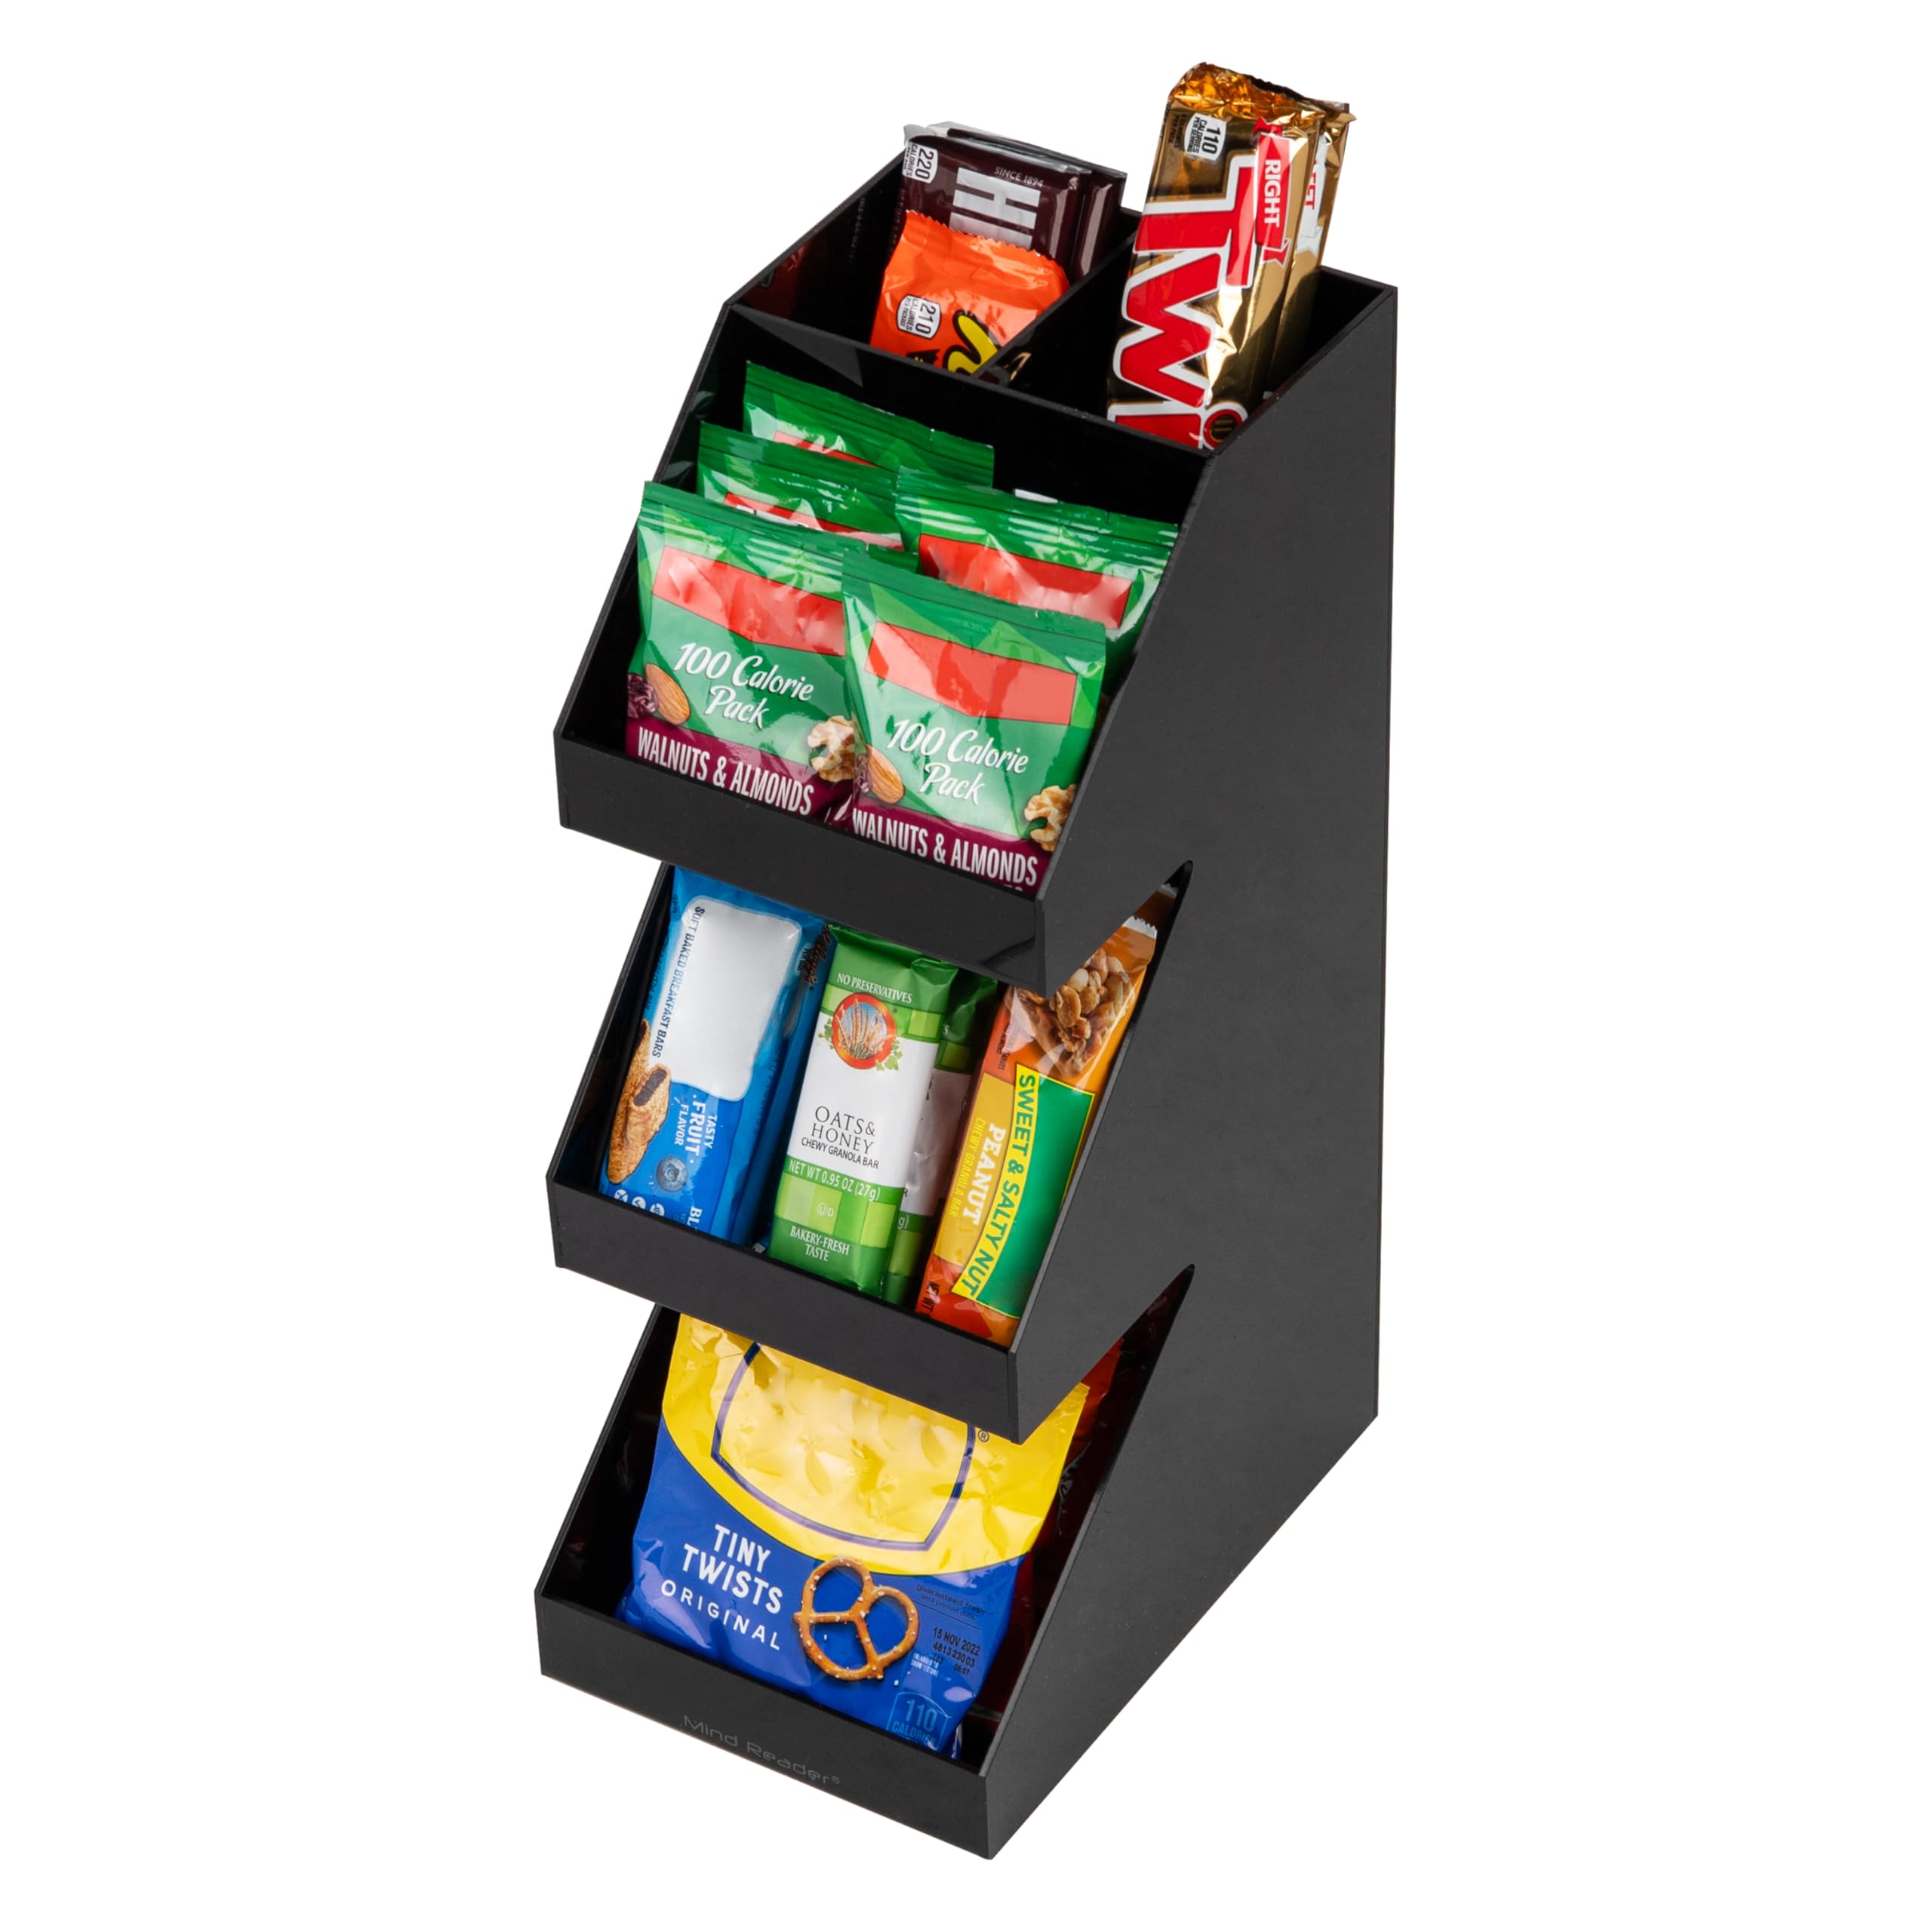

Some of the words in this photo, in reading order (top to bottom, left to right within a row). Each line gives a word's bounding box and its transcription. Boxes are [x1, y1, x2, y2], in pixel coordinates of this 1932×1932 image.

[1192, 119, 1208, 153] CALORIES
[1201, 127, 1221, 154] 110
[906, 144, 918, 176] CALORIES
[915, 148, 934, 180] 220
[994, 166, 1023, 182] SINCE
[1023, 174, 1044, 188] 1894
[1264, 159, 1281, 228] RIGHT
[906, 298, 919, 331] CALORIES
[915, 303, 936, 334] 210
[673, 642, 731, 679] 100
[732, 655, 814, 700] Calorie
[705, 685, 770, 729] Pack
[887, 719, 946, 755] 100
[947, 730, 1029, 774] Calorie
[637, 726, 710, 781] WALNUTS
[713, 755, 727, 788] &
[730, 761, 814, 815] ALMONDS
[919, 761, 985, 805] Pack
[852, 808, 928, 857] WALNUTS
[934, 833, 946, 864] &
[951, 838, 1038, 886] ALMONDS
[688, 906, 705, 931] SOFT
[677, 933, 695, 968] BAKED
[660, 968, 684, 1030] BREAKFAST
[837, 973, 851, 985] NO
[851, 977, 913, 1004] PRESERVATIVES
[652, 1029, 667, 1058] BARS
[675, 1103, 689, 1146] FLAVOR
[685, 1100, 706, 1156] FRUIT
[704, 1115, 718, 1149] TASTY
[1012, 1074, 1035, 1157] SWEET
[811, 1122, 874, 1154] HONEY
[968, 1117, 986, 1152] CHEWY
[801, 1137, 828, 1152] CHEWY
[828, 1145, 861, 1164] GRANOLA
[863, 1157, 879, 1169] BAR
[1007, 1159, 1024, 1174] &
[789, 1161, 805, 1175] NET
[806, 1167, 821, 1180] WT
[822, 1172, 838, 1187] 0.95
[842, 1177, 853, 1192] OZ
[854, 1183, 880, 1201] (27g)
[955, 1153, 976, 1195] GRANOLA
[963, 1123, 1007, 1226] PEANUT
[949, 1197, 961, 1217] BAR
[986, 1180, 1020, 1250] SALTY
[790, 1226, 850, 1256] BAKERY-FRESH
[805, 1243, 829, 1262] TASTE
[961, 1248, 995, 1296] NUT
[714, 1524, 771, 1573] TINY
[682, 1543, 783, 1614] TWISTS
[916, 1584, 964, 1607] guaranteed
[660, 1579, 780, 1651] ORIGINAL
[933, 1626, 943, 1639] 15
[943, 1631, 961, 1646] NOV
[961, 1639, 981, 1657] 2022
[683, 1715, 738, 1746] Mind
[906, 1699, 938, 1732] 110
[892, 1721, 936, 1746] CALORIES
